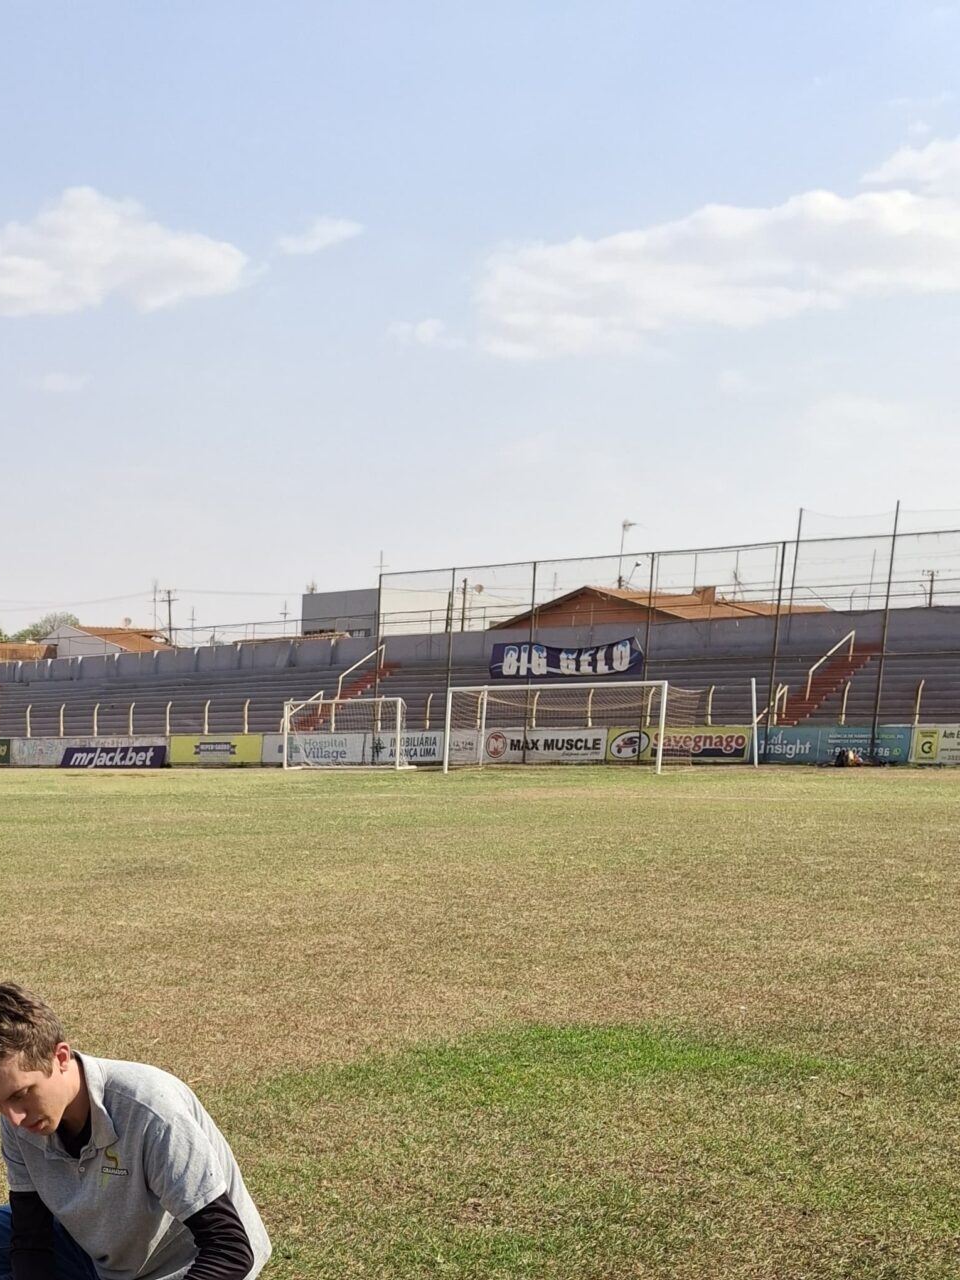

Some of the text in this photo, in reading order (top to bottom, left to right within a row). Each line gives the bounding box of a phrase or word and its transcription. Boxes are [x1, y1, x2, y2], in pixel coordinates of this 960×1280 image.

[502, 640, 630, 675] BIG GELO
[304, 738, 348, 749] Hospital
[510, 738, 602, 751] MAX MUSCLE
[652, 732, 746, 753] Savegnago
[758, 739, 811, 758] Insight
[304, 747, 347, 760] Village
[419, 747, 436, 758] LIMA
